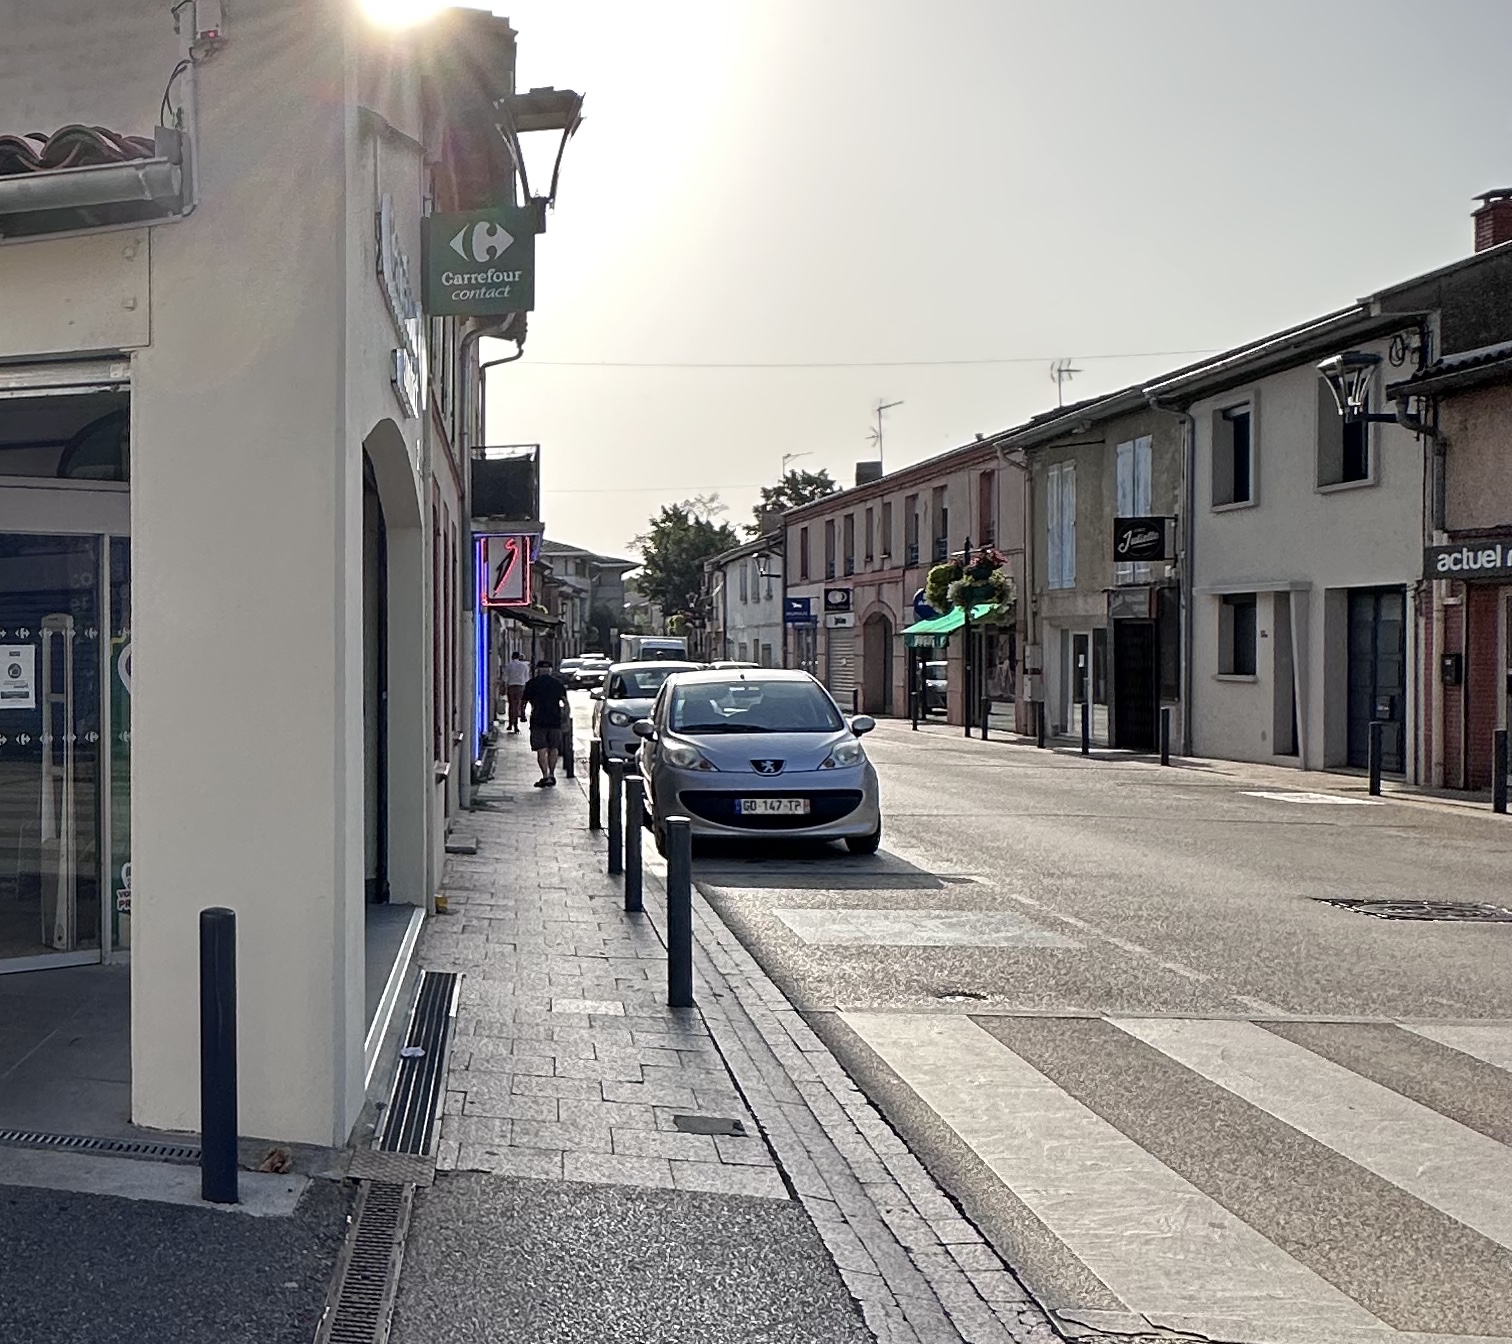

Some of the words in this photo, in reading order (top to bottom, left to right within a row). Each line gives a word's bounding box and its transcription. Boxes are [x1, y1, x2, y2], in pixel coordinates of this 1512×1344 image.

[441, 268, 523, 285] Carrefour
[451, 285, 511, 300] contact
[1436, 544, 1502, 572] actuel
